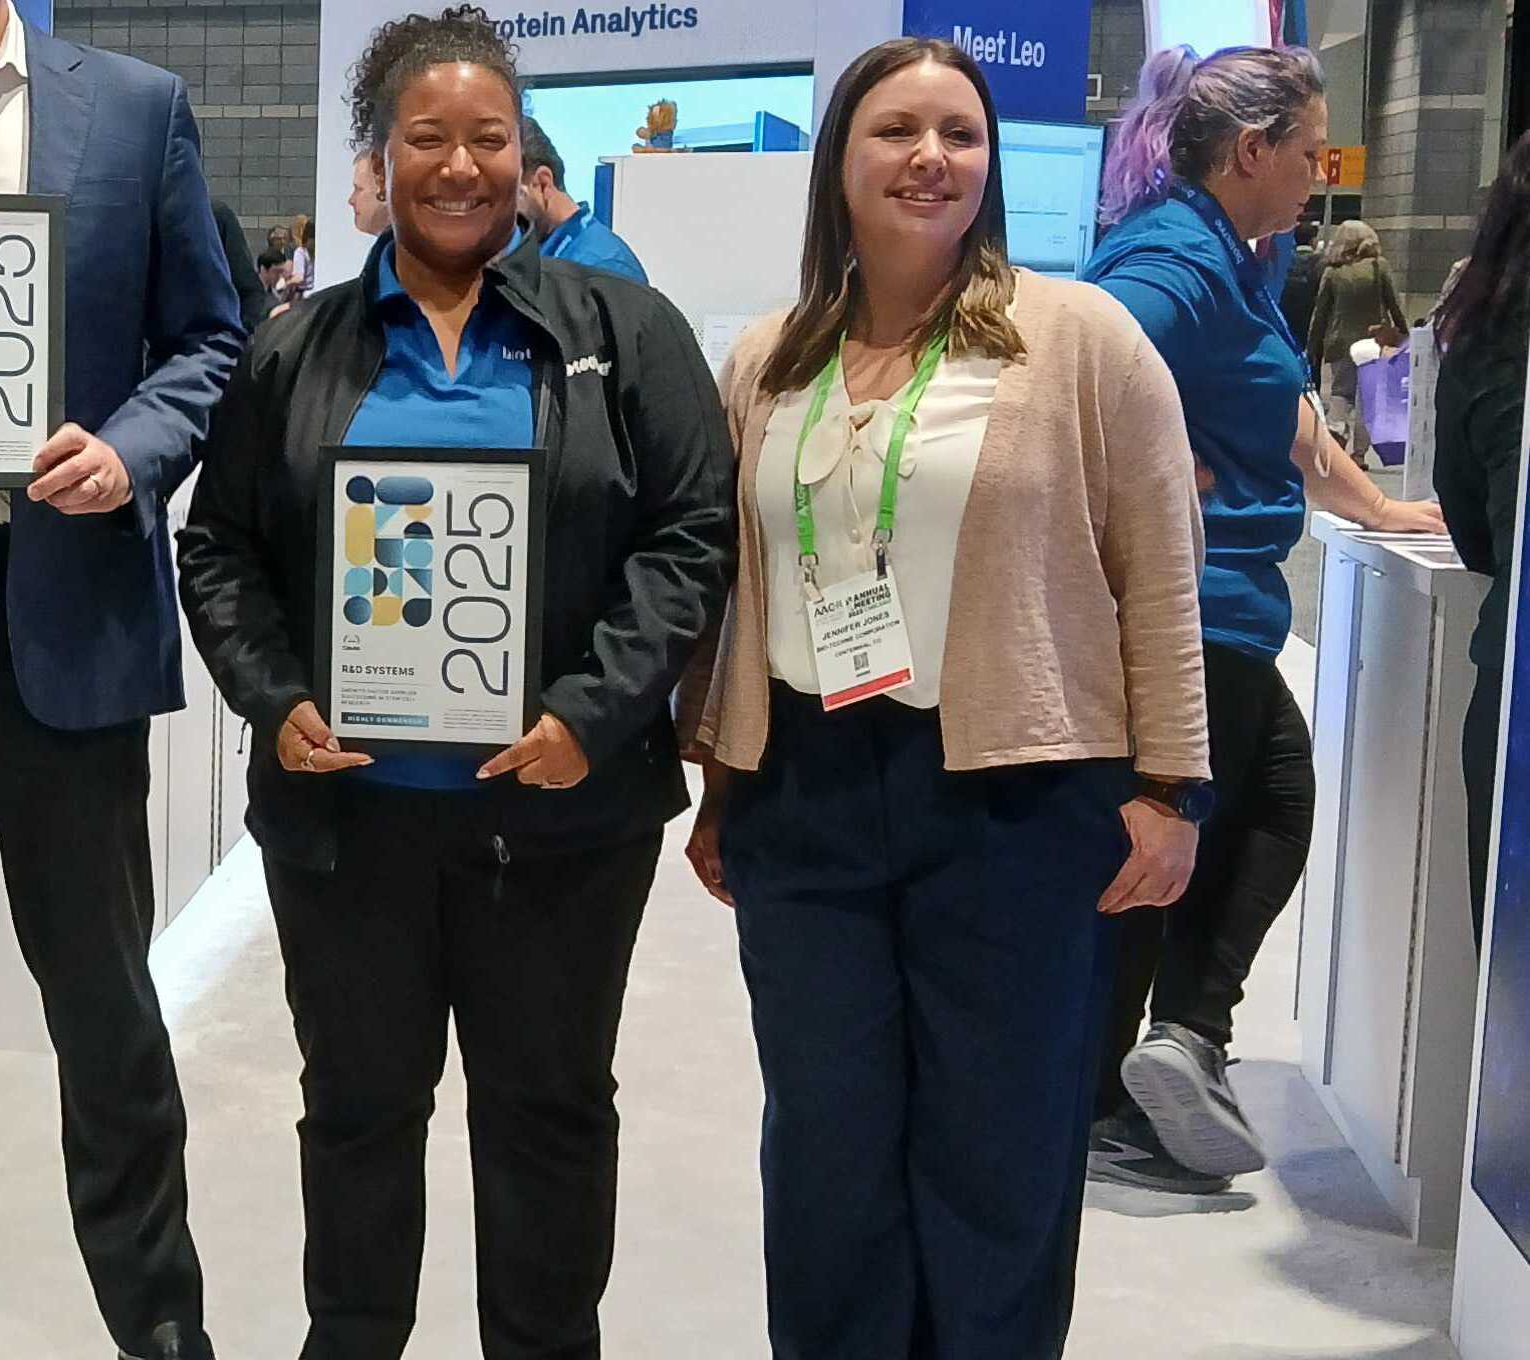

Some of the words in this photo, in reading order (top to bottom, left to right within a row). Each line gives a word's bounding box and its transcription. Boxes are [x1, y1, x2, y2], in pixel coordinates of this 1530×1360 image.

[493, 11, 566, 39] rotein
[571, 3, 698, 38] Analytics
[953, 25, 1006, 64] Meet
[1010, 31, 1045, 68] Leo
[441, 490, 515, 696] 2025
[342, 665, 363, 674] R&D
[365, 665, 415, 676] SYSTEMS
